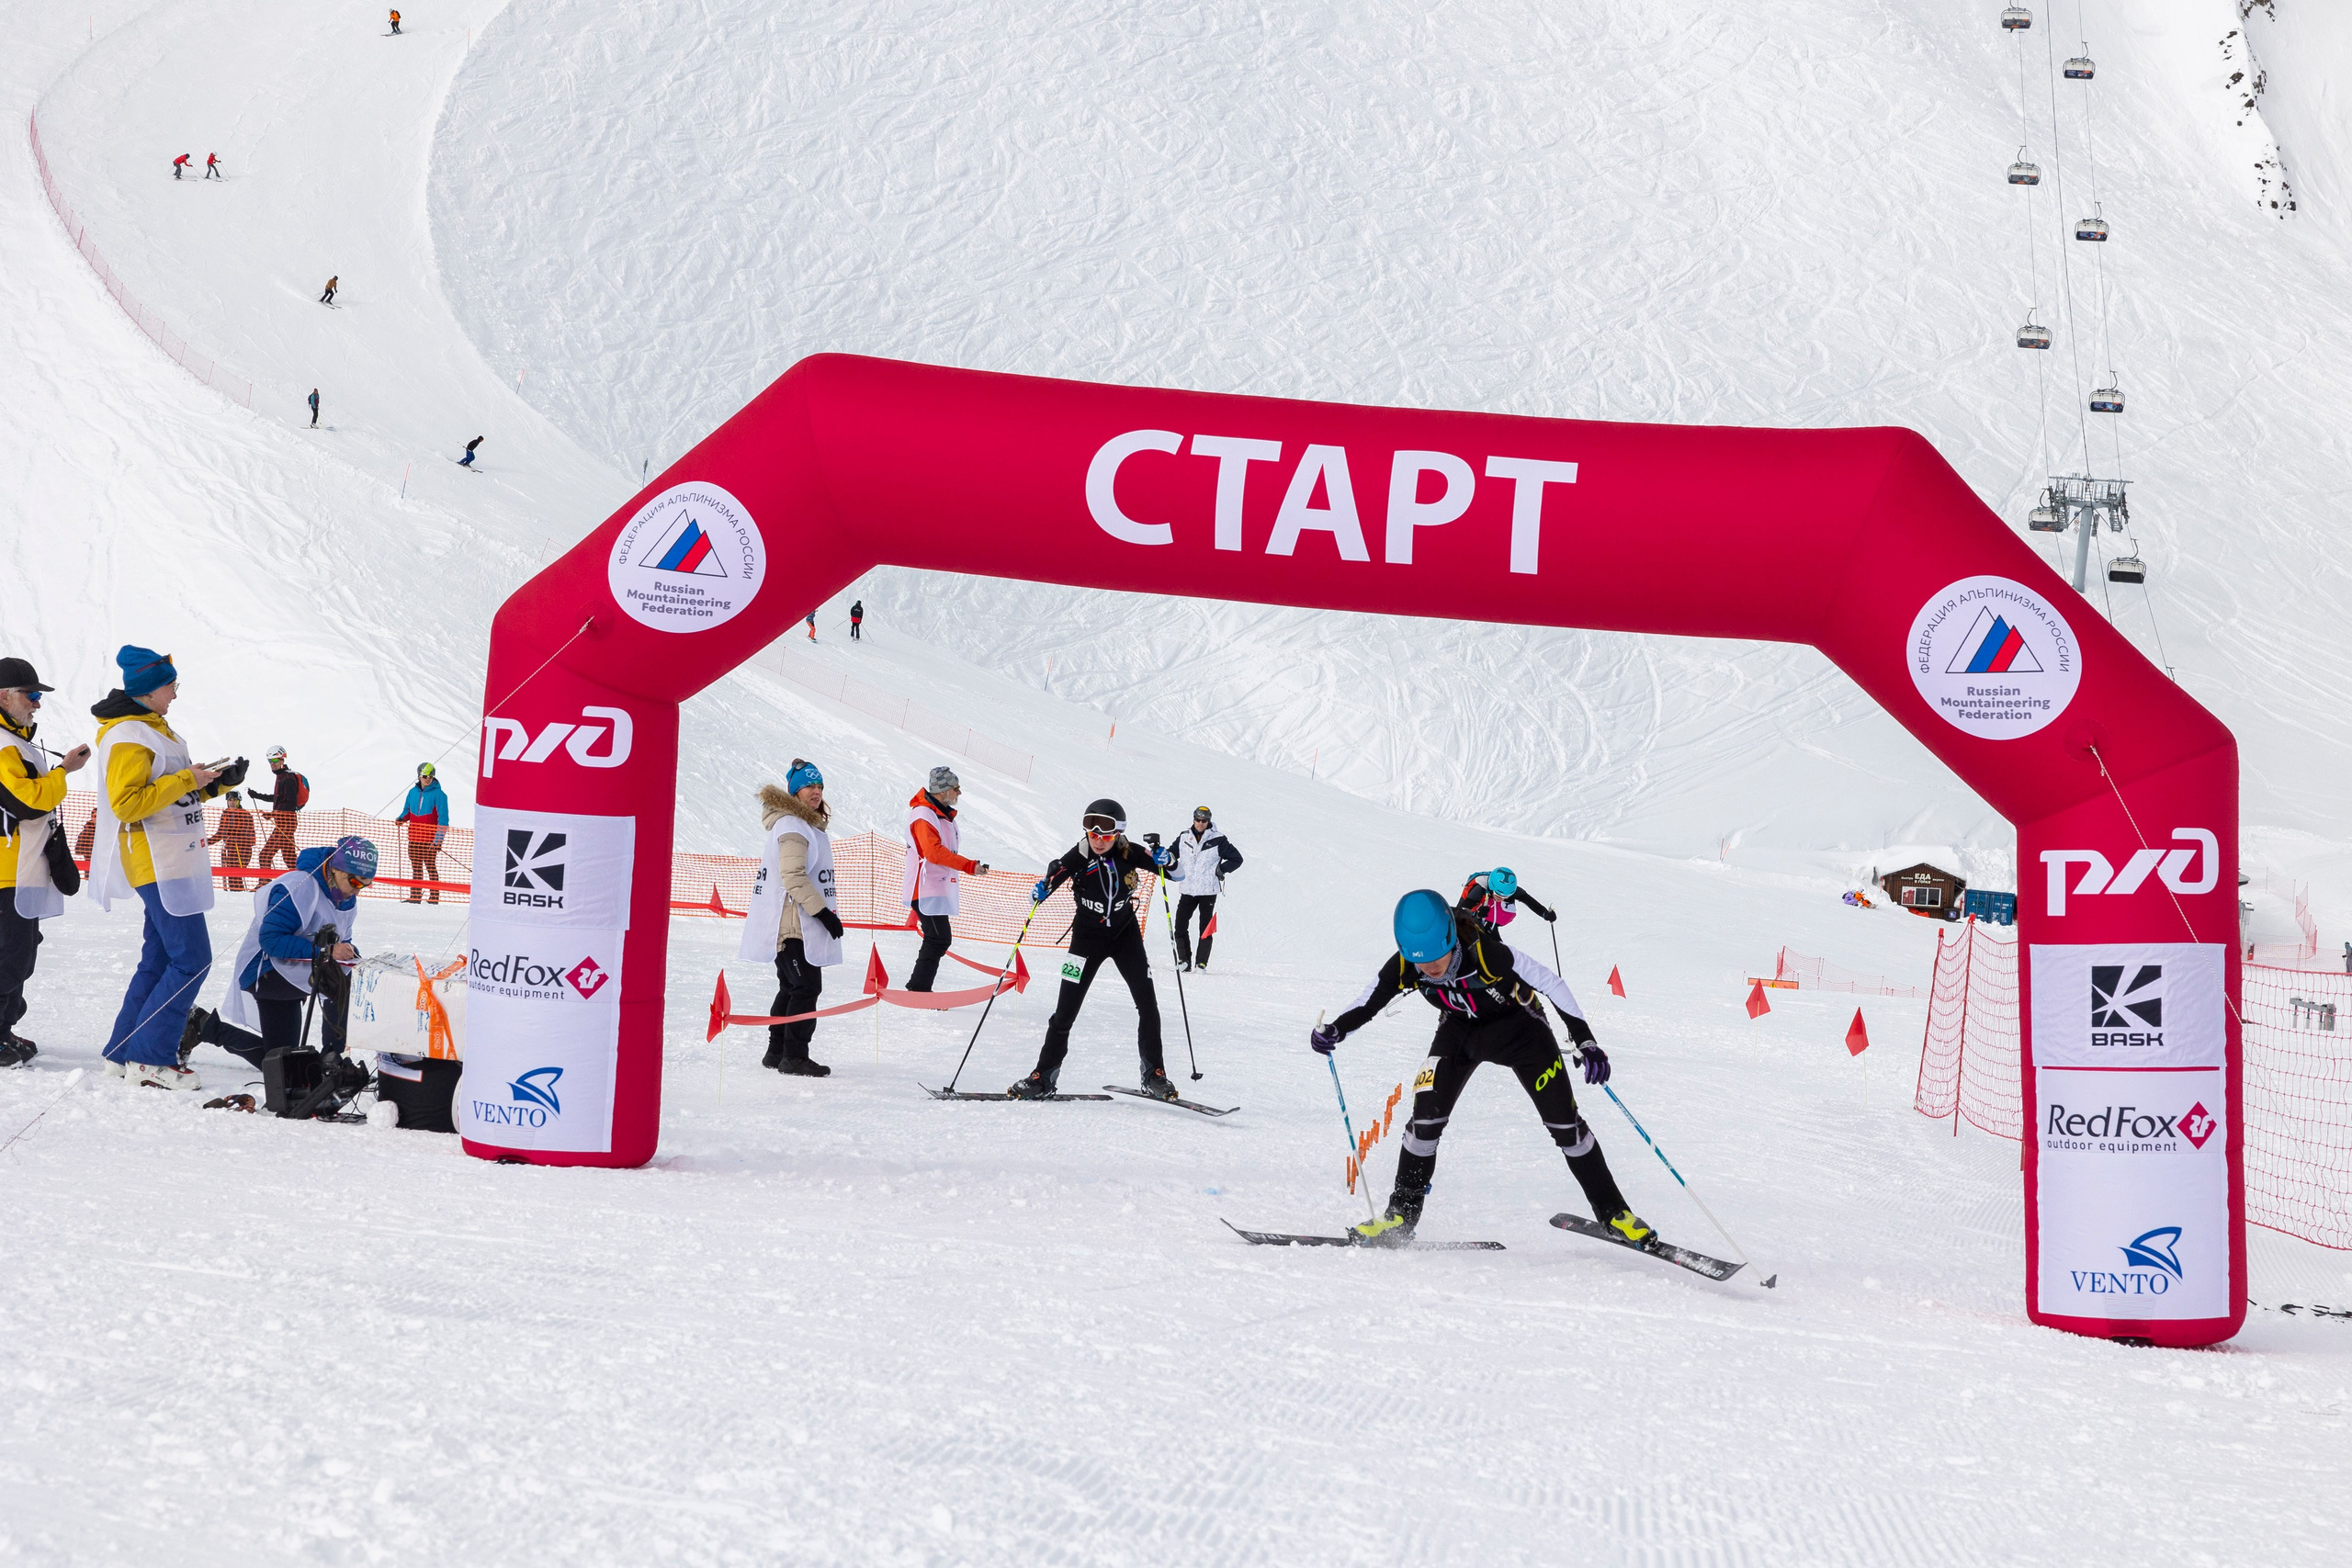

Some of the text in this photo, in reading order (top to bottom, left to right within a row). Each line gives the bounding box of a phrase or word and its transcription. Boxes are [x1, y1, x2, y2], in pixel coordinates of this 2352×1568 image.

[1085, 429, 1578, 575] СТАРТ
[618, 492, 754, 581] ФЕДЕРАЦИЯ АЛЬПИНИЗМА РОССИИ
[653, 581, 705, 596] Russian
[627, 588, 732, 610] Mountaineering
[641, 602, 714, 617] Federation
[1918, 587, 2070, 674] ФЕДЕРАЦИЯ АЛЬПИНИЗМА РОССИИ
[1966, 684, 2021, 696] Russian
[1940, 696, 2051, 710] Mountaineering
[1958, 709, 2032, 720] Federation
[503, 891, 564, 909] BASK
[1062, 963, 1081, 977] 223
[469, 979, 495, 993] outdoor
[499, 986, 565, 1000] equipment
[2091, 1032, 2165, 1046] BASK
[472, 1100, 547, 1128] VENTO
[2047, 1138, 2177, 1154] outdoor equipment
[2070, 1270, 2170, 1295] VENTO
